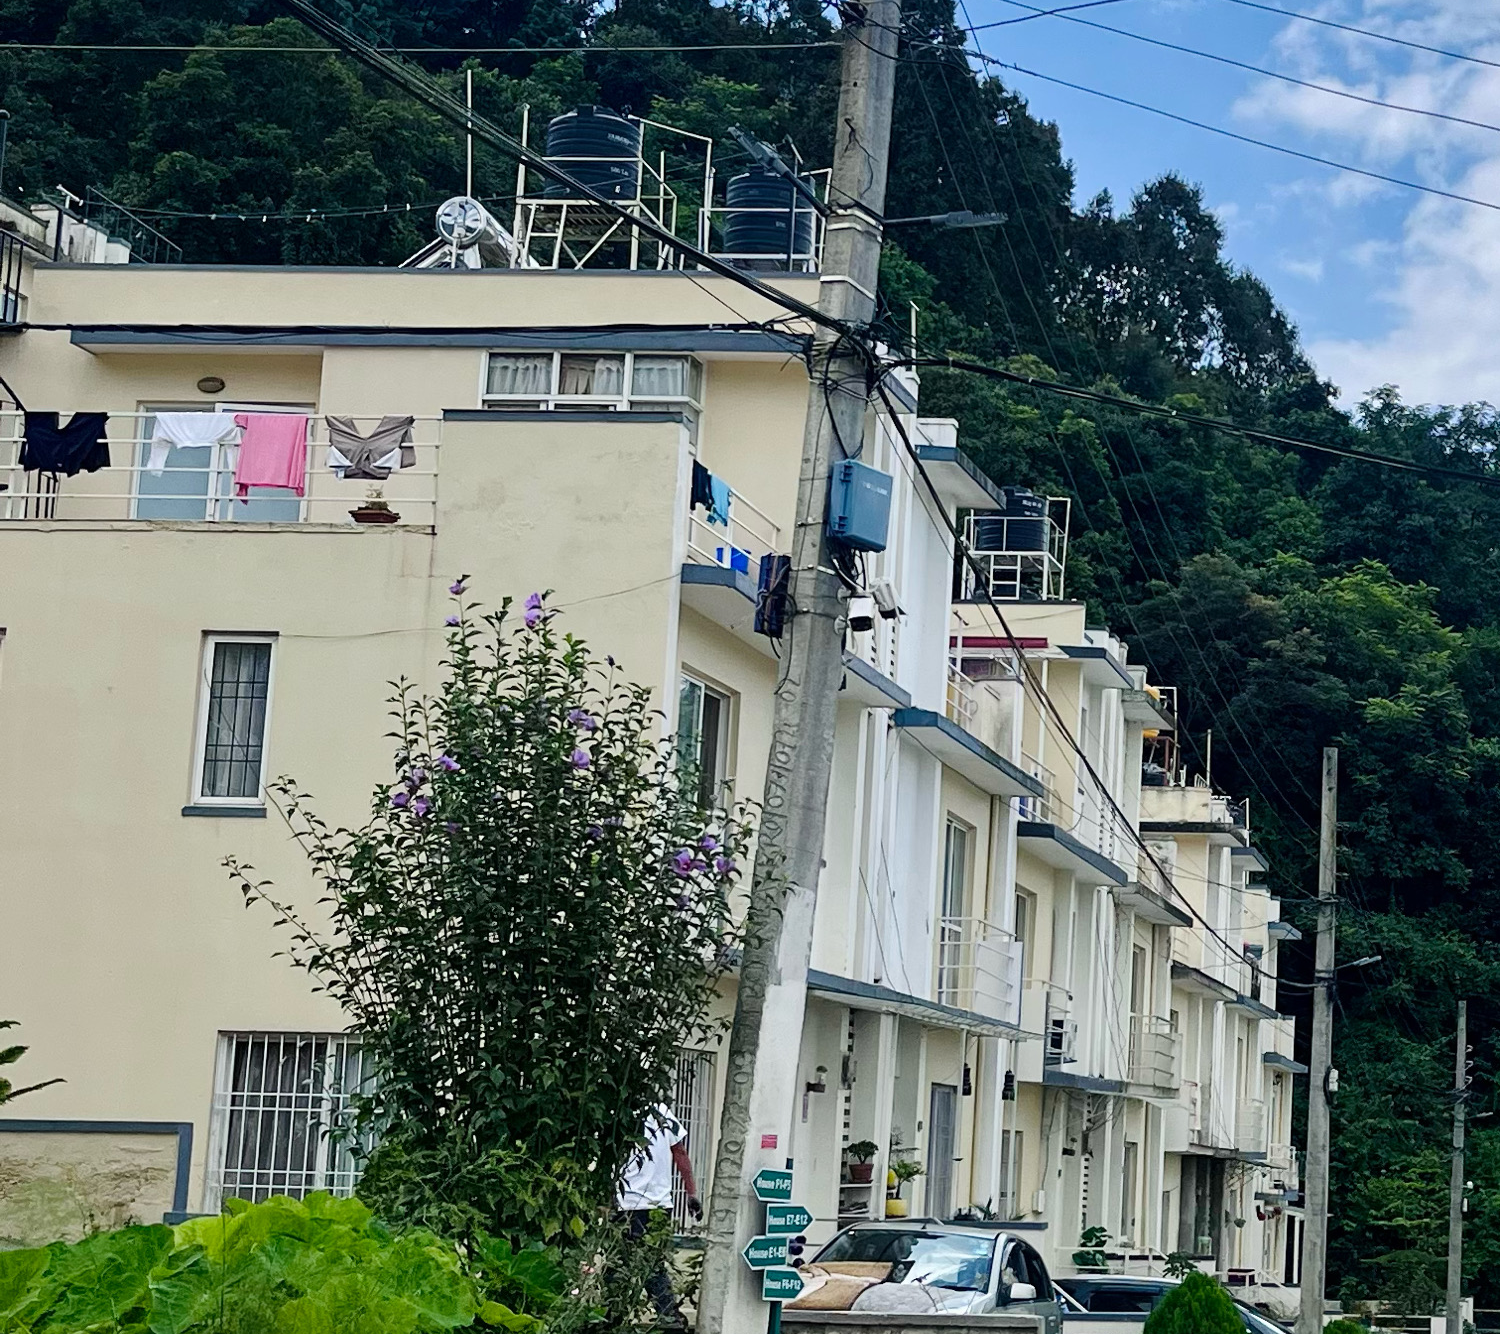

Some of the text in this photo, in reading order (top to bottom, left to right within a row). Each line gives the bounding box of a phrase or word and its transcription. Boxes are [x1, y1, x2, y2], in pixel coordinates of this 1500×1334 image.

[756, 1177, 775, 1190] House
[769, 1214, 809, 1225] House E7-E12
[748, 1247, 768, 1258] House
[765, 1278, 781, 1289] House
